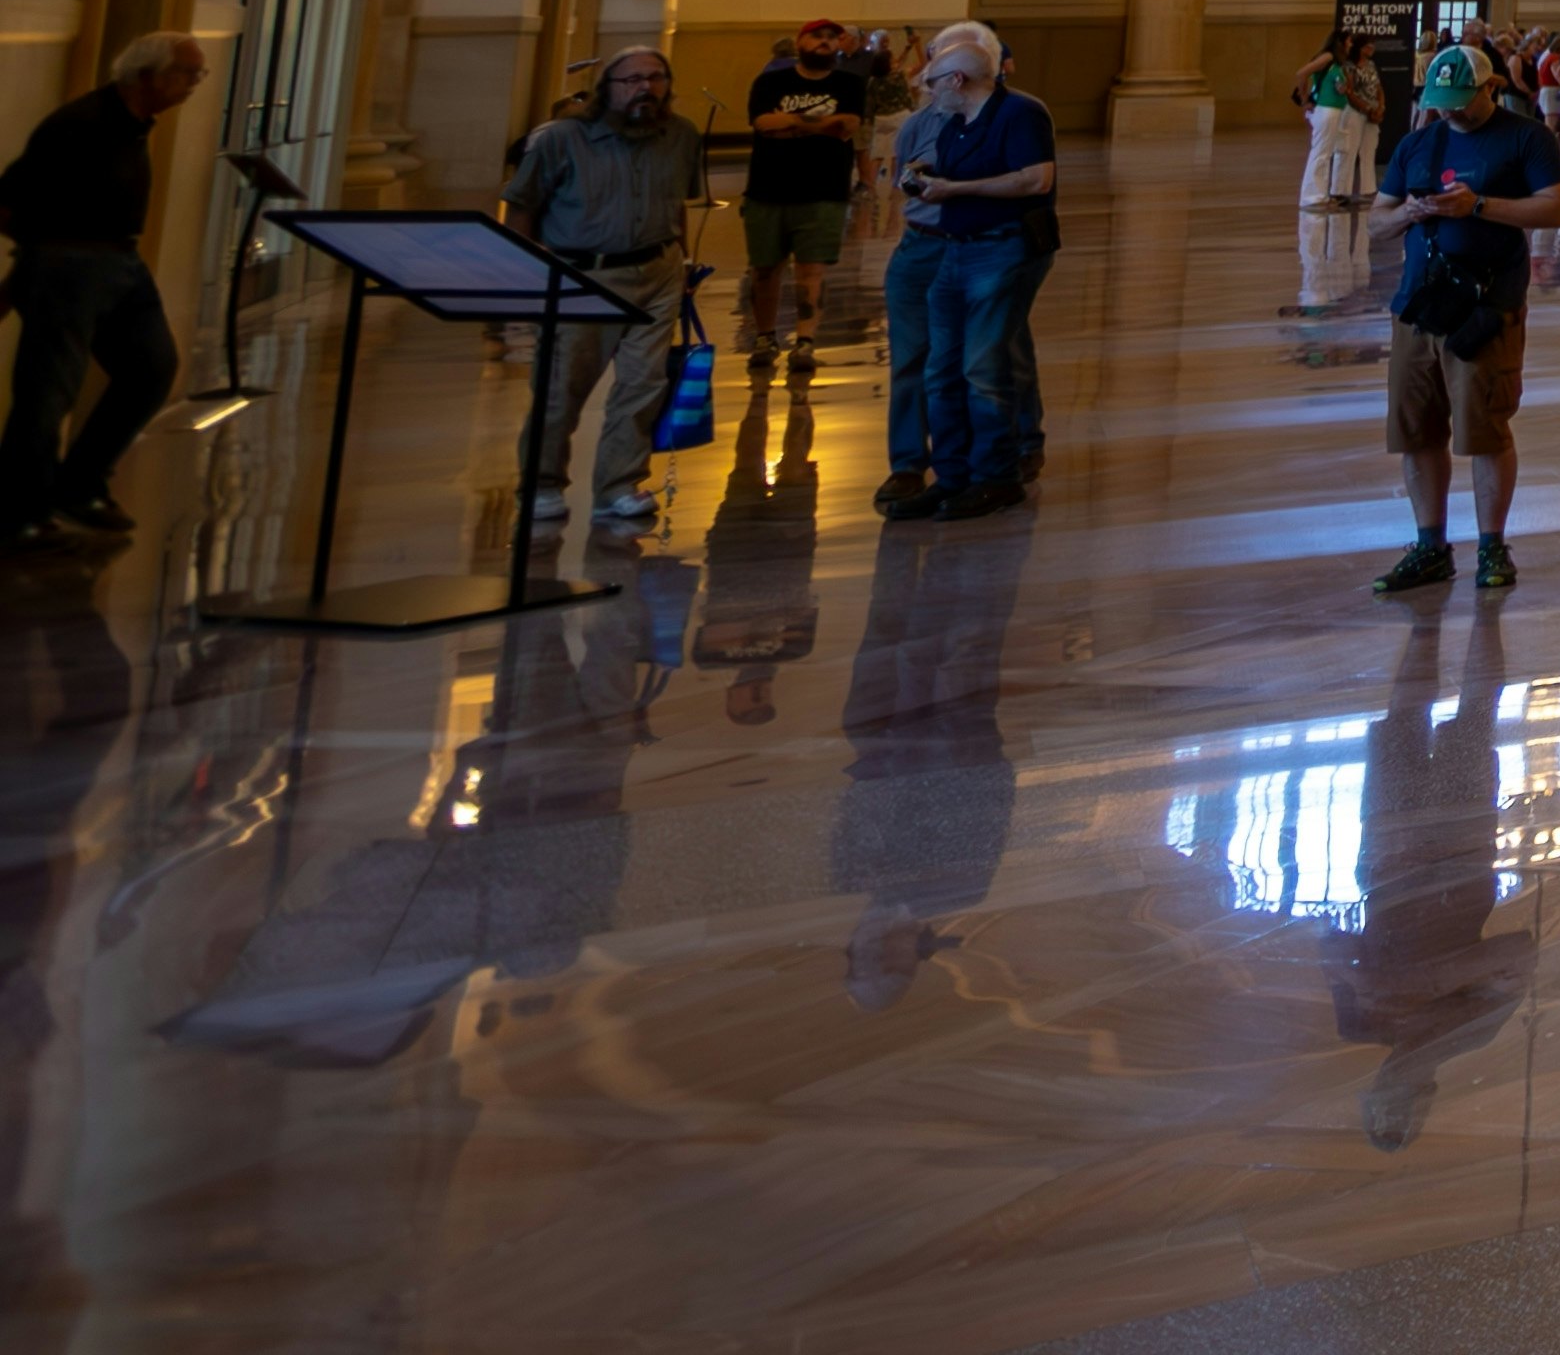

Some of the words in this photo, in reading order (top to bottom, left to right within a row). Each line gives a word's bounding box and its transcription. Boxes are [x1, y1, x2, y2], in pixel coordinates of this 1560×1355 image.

[1343, 4, 1369, 14] THE
[1372, 4, 1414, 14] STORY
[1343, 15, 1360, 24] OF
[1364, 15, 1389, 24] THE
